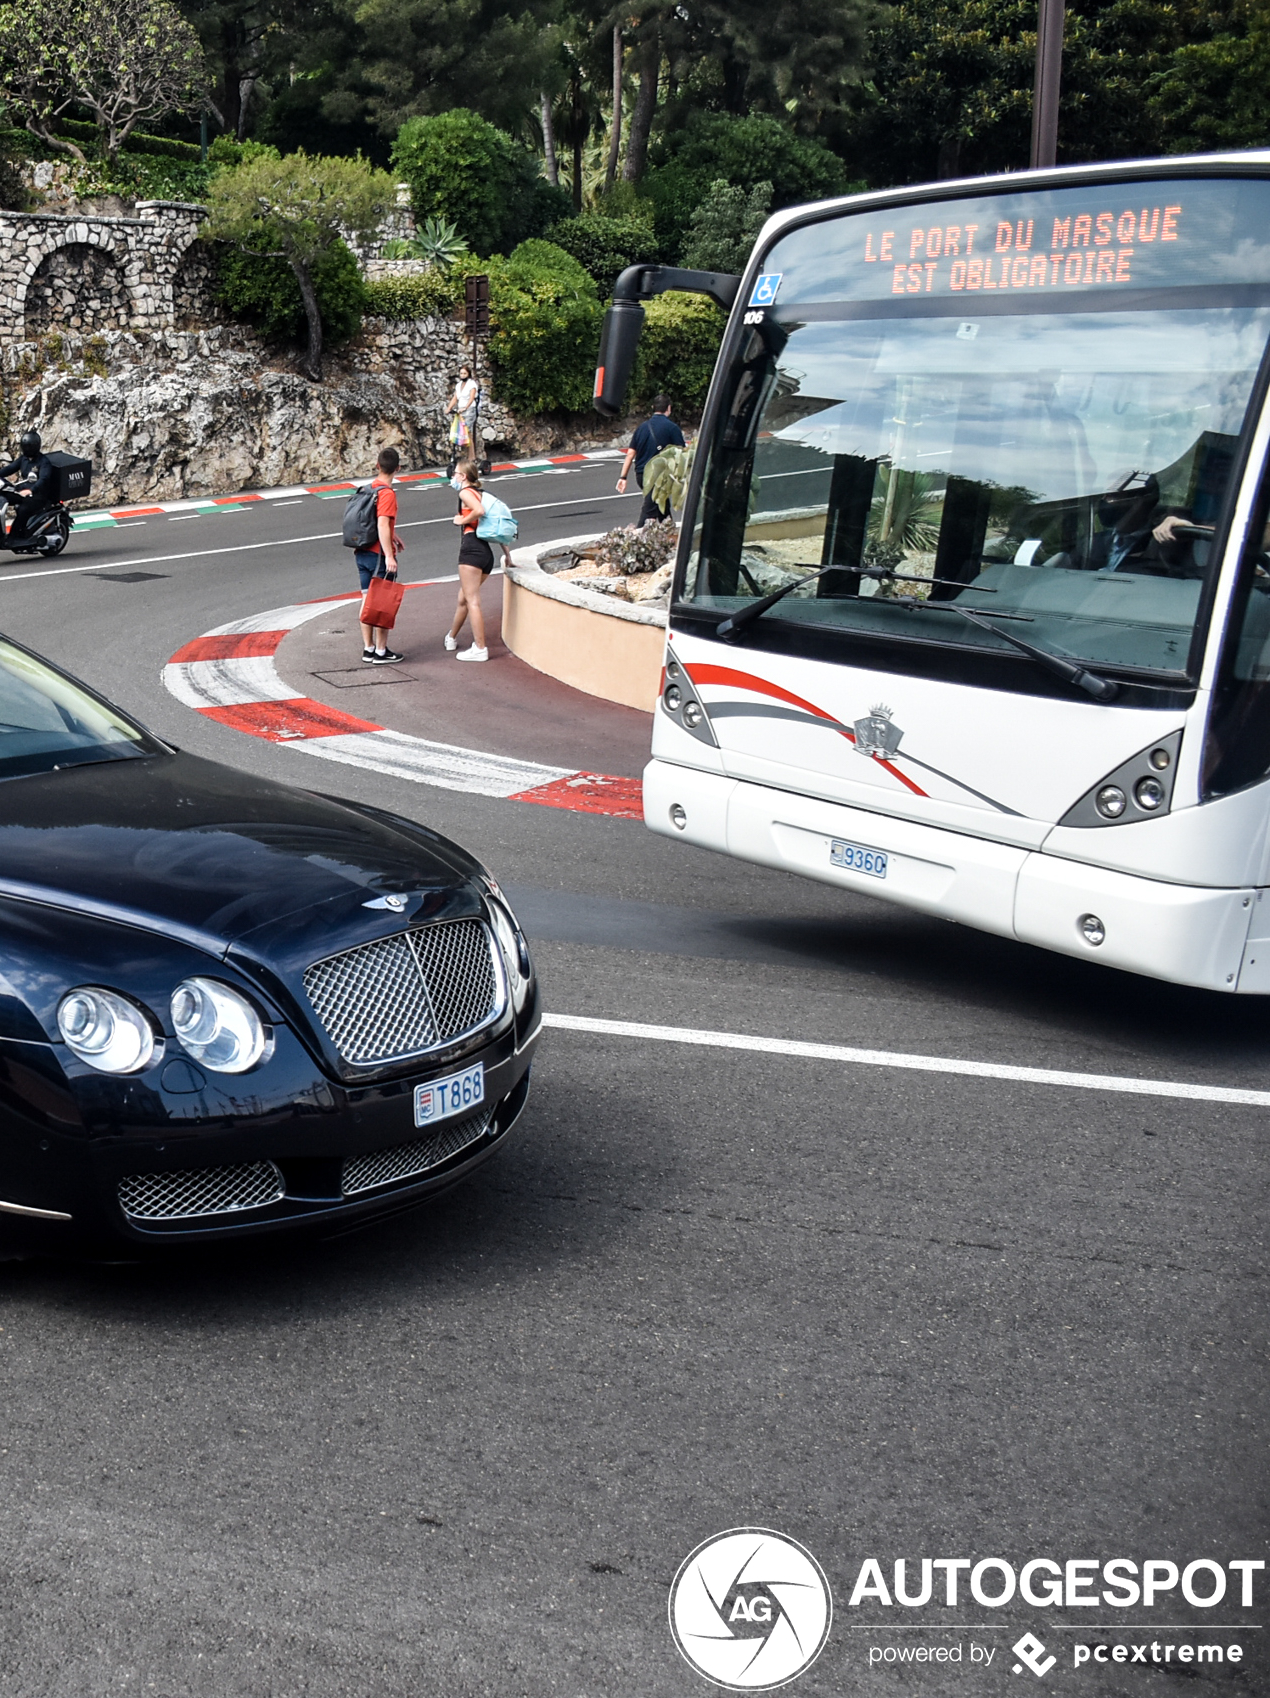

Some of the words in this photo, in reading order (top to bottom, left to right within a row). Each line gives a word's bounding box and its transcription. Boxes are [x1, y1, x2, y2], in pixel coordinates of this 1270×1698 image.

[864, 231, 895, 263] LE
[909, 224, 980, 259] PORT
[994, 219, 1035, 253] DU
[1050, 205, 1183, 250] MASQUE
[891, 262, 938, 294] EST
[949, 248, 1135, 291] OBLIGATOIRE
[743, 310, 765, 325] 106
[844, 847, 884, 874] 9360
[421, 1104, 431, 1113] MC
[436, 1070, 481, 1114] T868
